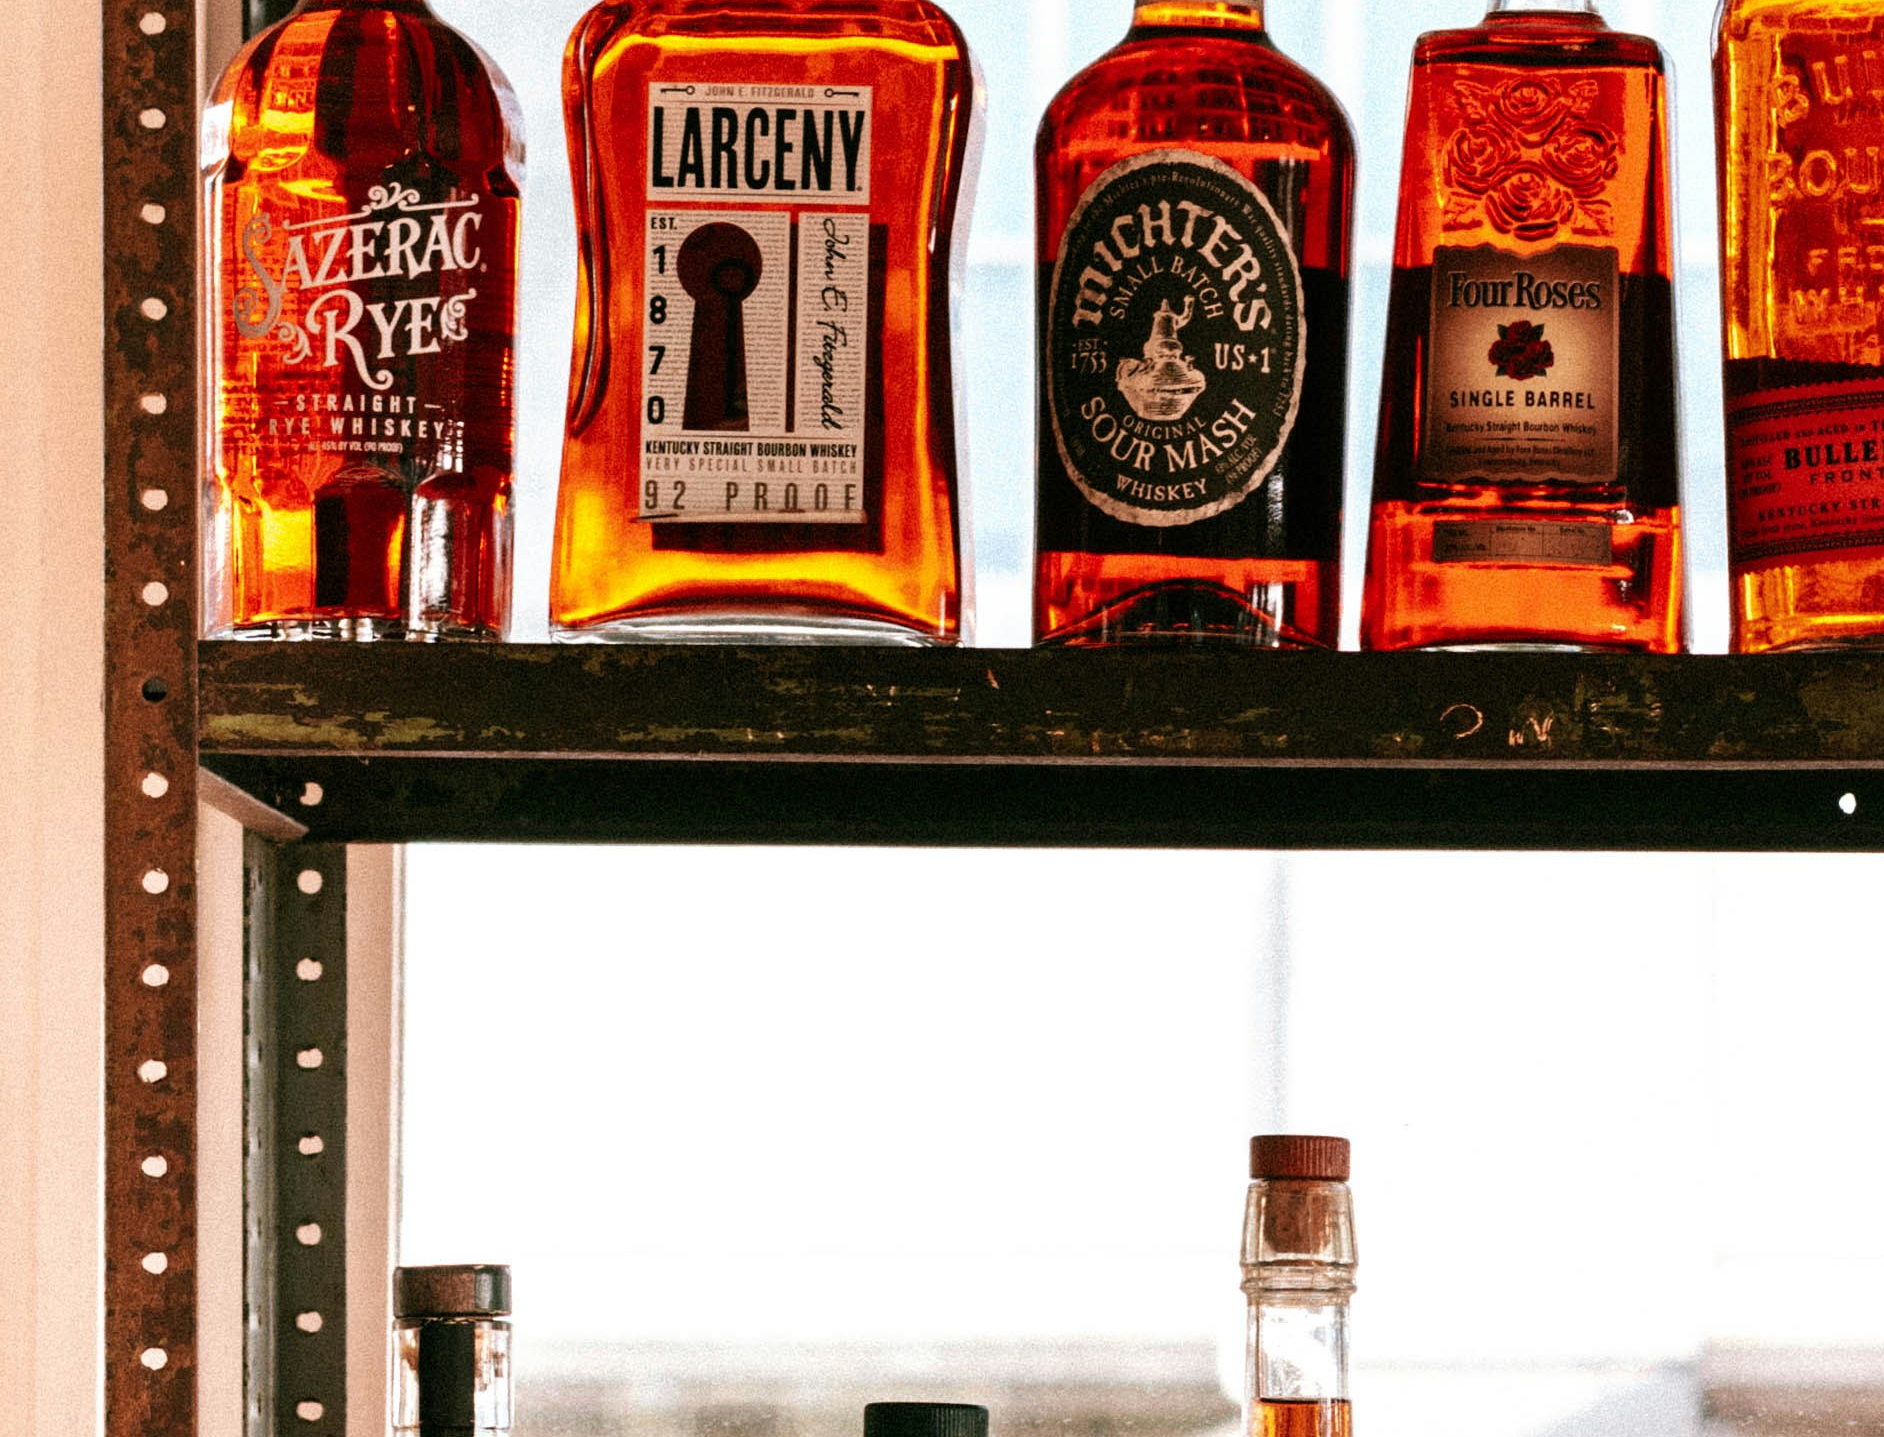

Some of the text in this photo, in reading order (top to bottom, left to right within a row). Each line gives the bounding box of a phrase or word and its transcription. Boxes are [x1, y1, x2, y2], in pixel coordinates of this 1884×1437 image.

[705, 86, 735, 98] JOHN
[751, 86, 815, 99] FITZGERALD
[652, 106, 866, 192] LARCENY
[651, 217, 678, 230] EST.
[233, 212, 482, 338] SAZERAC
[1071, 200, 1272, 332] MICHTER'S
[1109, 254, 1225, 322] SMALL BATCH
[1448, 271, 1602, 310] Four Roses
[304, 288, 443, 390] RYE
[296, 394, 417, 413] STRAIGHT
[1449, 390, 1595, 410] SINGLE BARREL
[1081, 396, 1257, 473] SOUR MASH
[1122, 415, 1208, 439] ORIGINAL
[646, 440, 857, 459] KENTUCKY STRAIGHT BOURBON WHISKEY
[644, 479, 858, 512] 92 PROOF
[1115, 472, 1208, 501] WHISKEY
[1757, 501, 1843, 522] KENTUCKY
